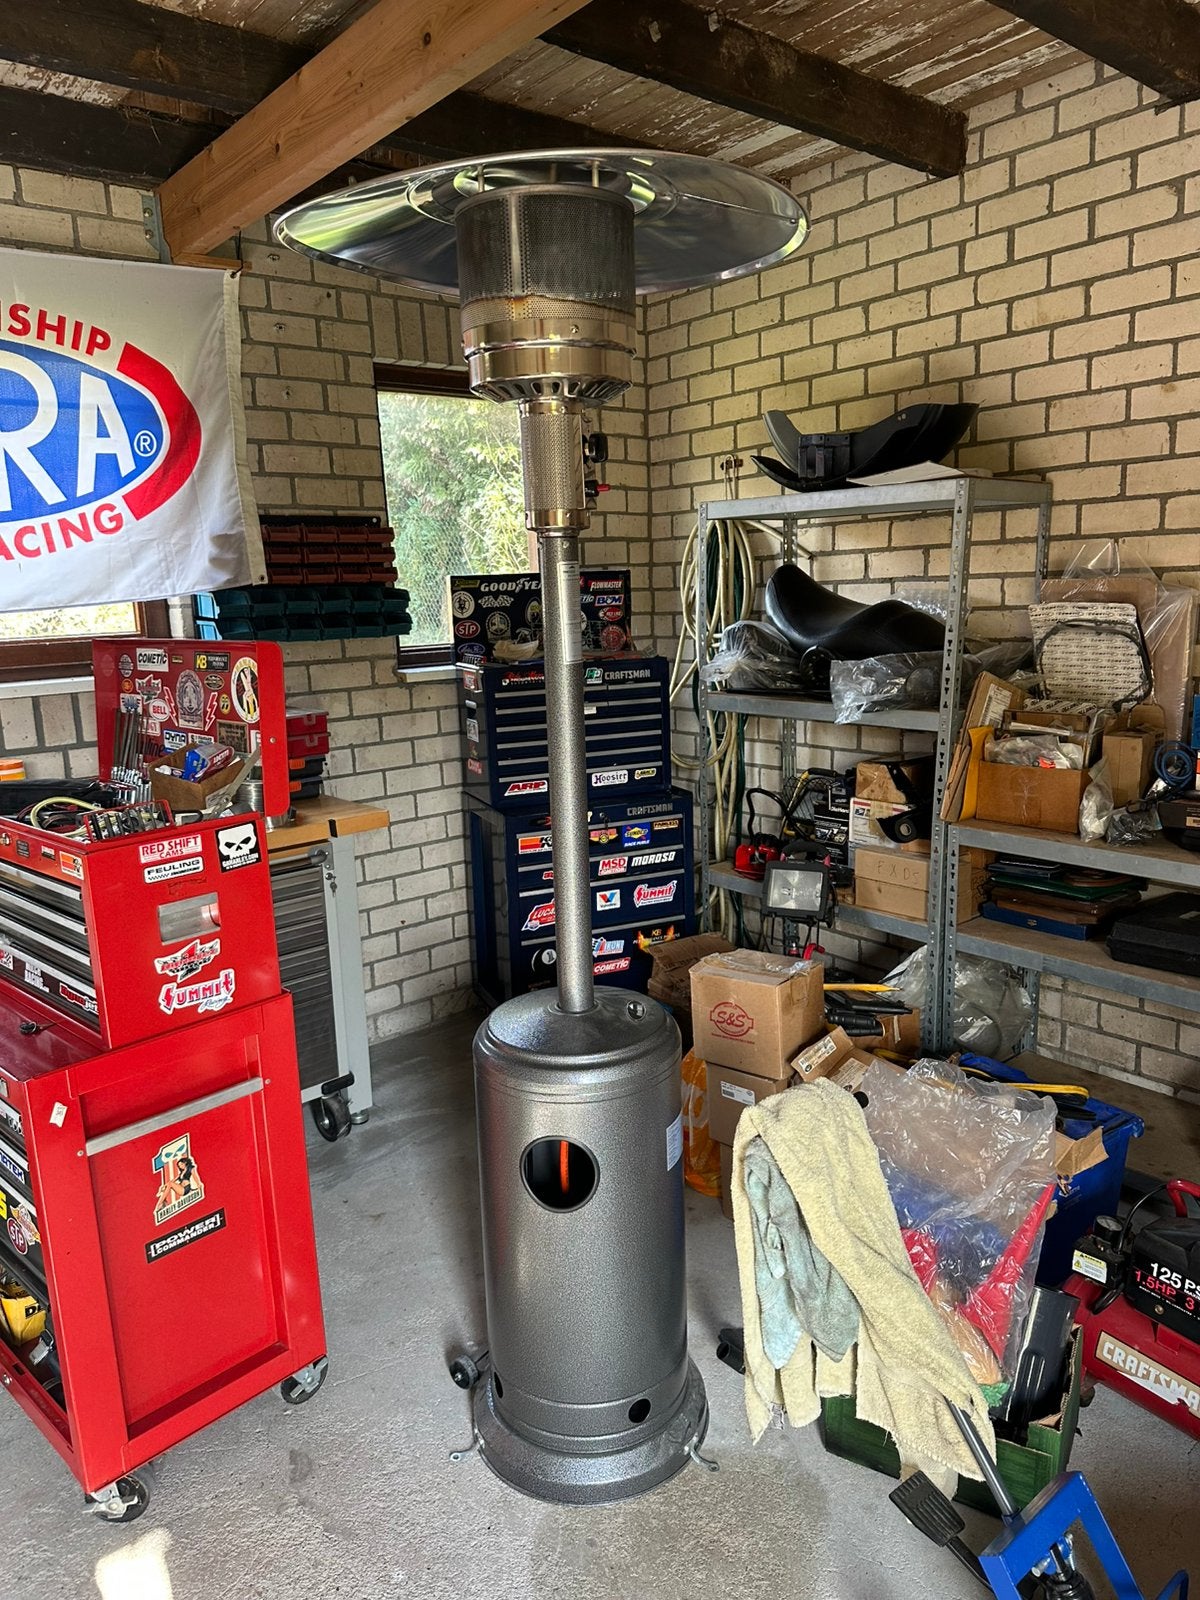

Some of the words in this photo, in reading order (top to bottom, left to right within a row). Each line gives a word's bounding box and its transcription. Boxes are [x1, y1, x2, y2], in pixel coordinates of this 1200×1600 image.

[0, 302, 112, 356] SHIP
[458, 622, 476, 635] STP
[138, 653, 167, 664] COMETIC
[604, 669, 651, 680] CRAFTSMAN
[152, 705, 168, 715] BELL
[508, 781, 547, 792] ARP
[626, 802, 674, 816] CRAFTSMAN
[141, 843, 165, 857] RED
[167, 835, 200, 851] SHIFT
[159, 848, 185, 859] CAMS
[601, 858, 626, 869] MSD
[631, 851, 676, 867] MOROSO
[147, 859, 201, 876] FEULING
[593, 960, 629, 973] COMETIC
[164, 971, 233, 1010] SUMMIT
[716, 1010, 746, 1029] S&S
[10, 1225, 25, 1247] STP
[155, 1214, 216, 1249] POWER
[157, 1223, 215, 1254] COMMANDER
[1150, 1262, 1182, 1289] 125
[1134, 1269, 1177, 1296] 1.5HP
[1184, 1297, 1195, 1311] 3
